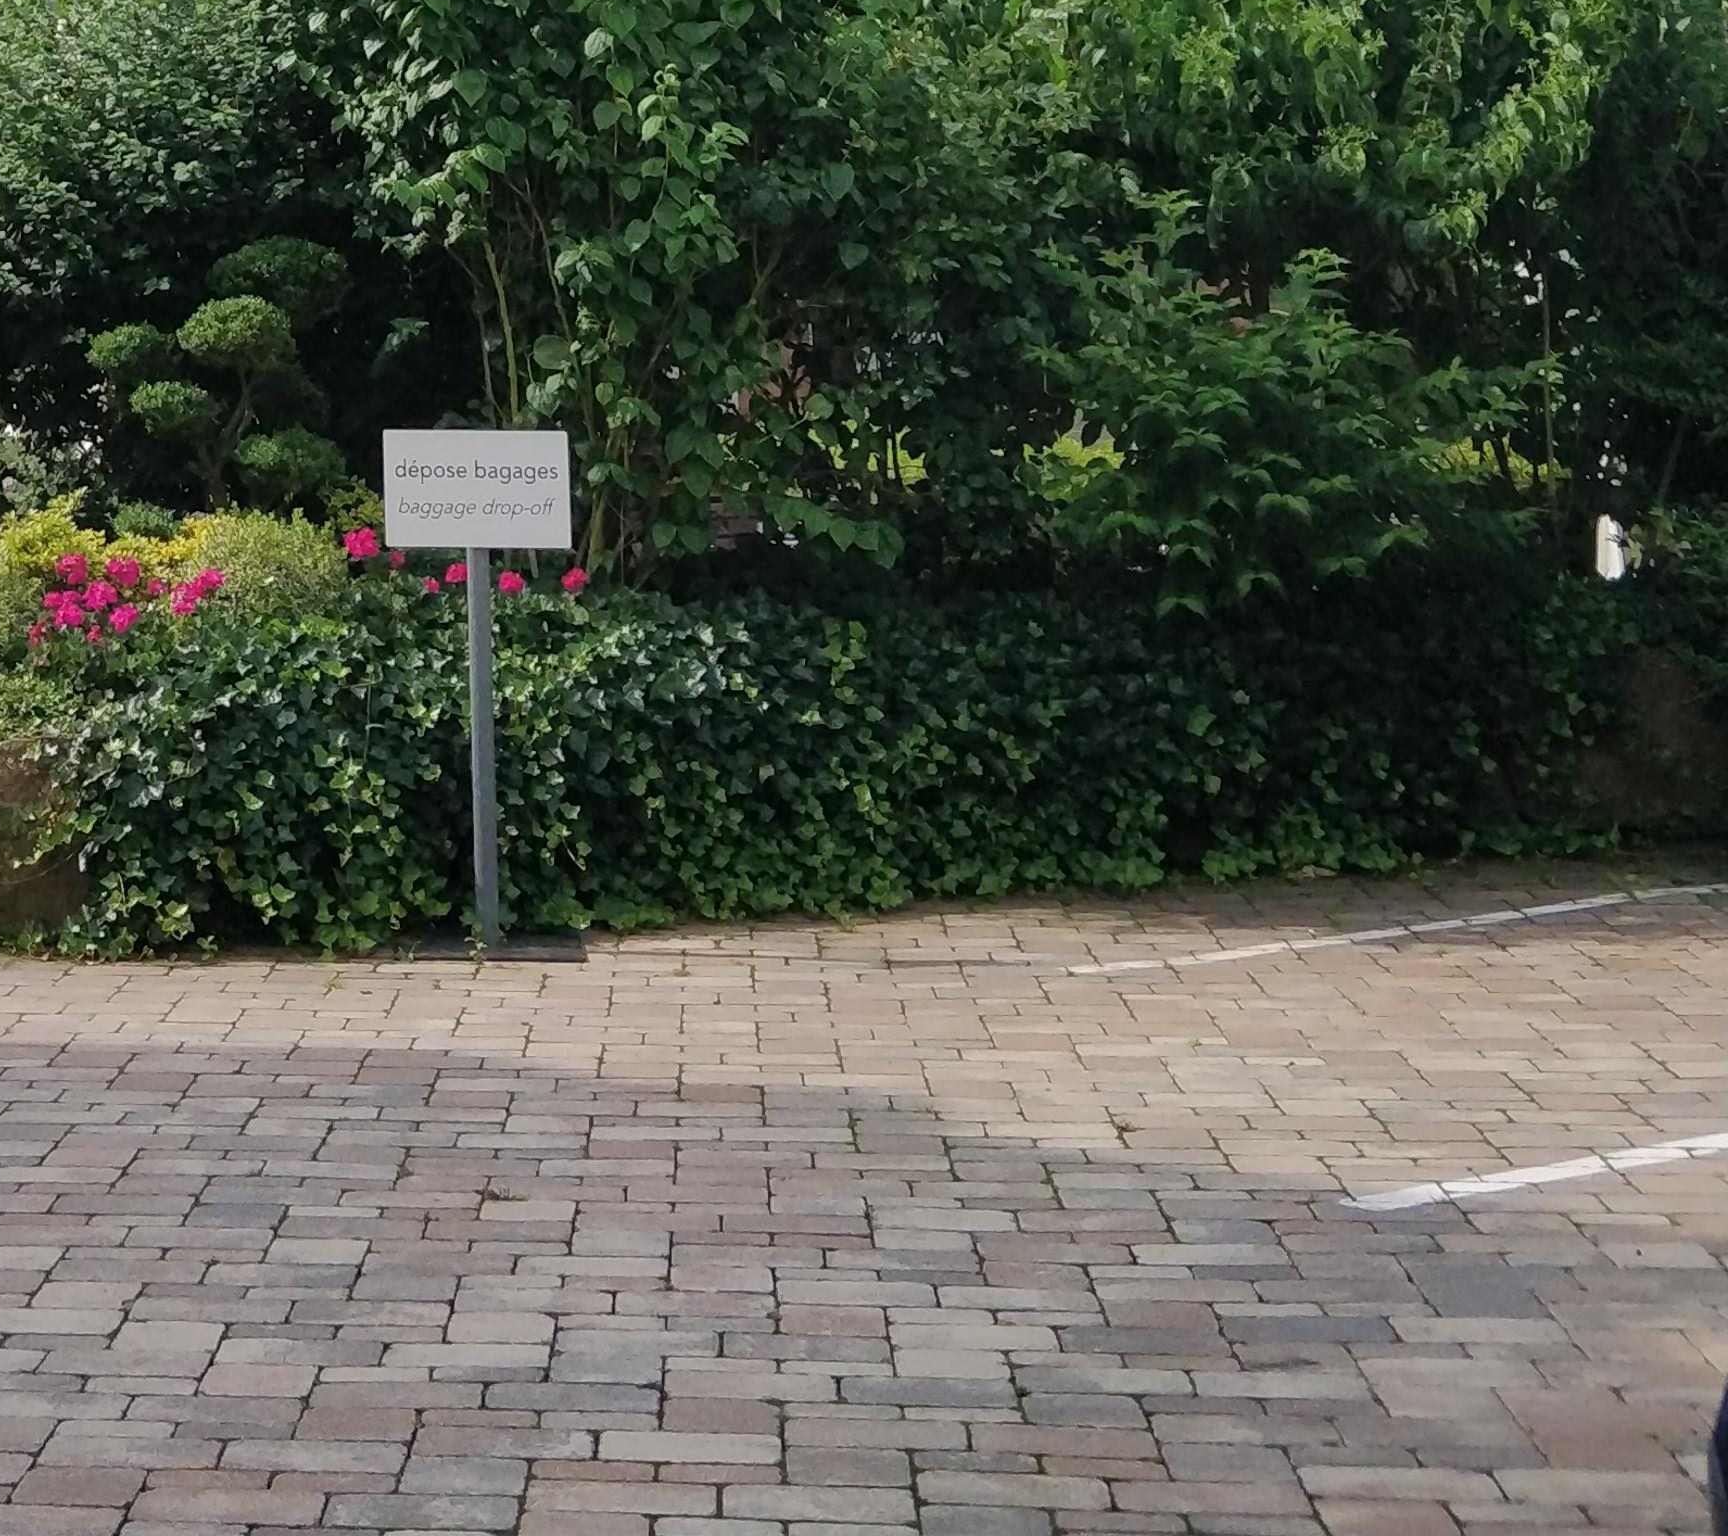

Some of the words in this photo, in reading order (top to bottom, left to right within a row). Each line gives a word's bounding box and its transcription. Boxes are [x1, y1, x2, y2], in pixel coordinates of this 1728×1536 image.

[394, 458, 468, 484] dépose
[474, 459, 559, 485] bagages
[398, 496, 477, 519] baggage
[482, 497, 557, 521] drop-off
